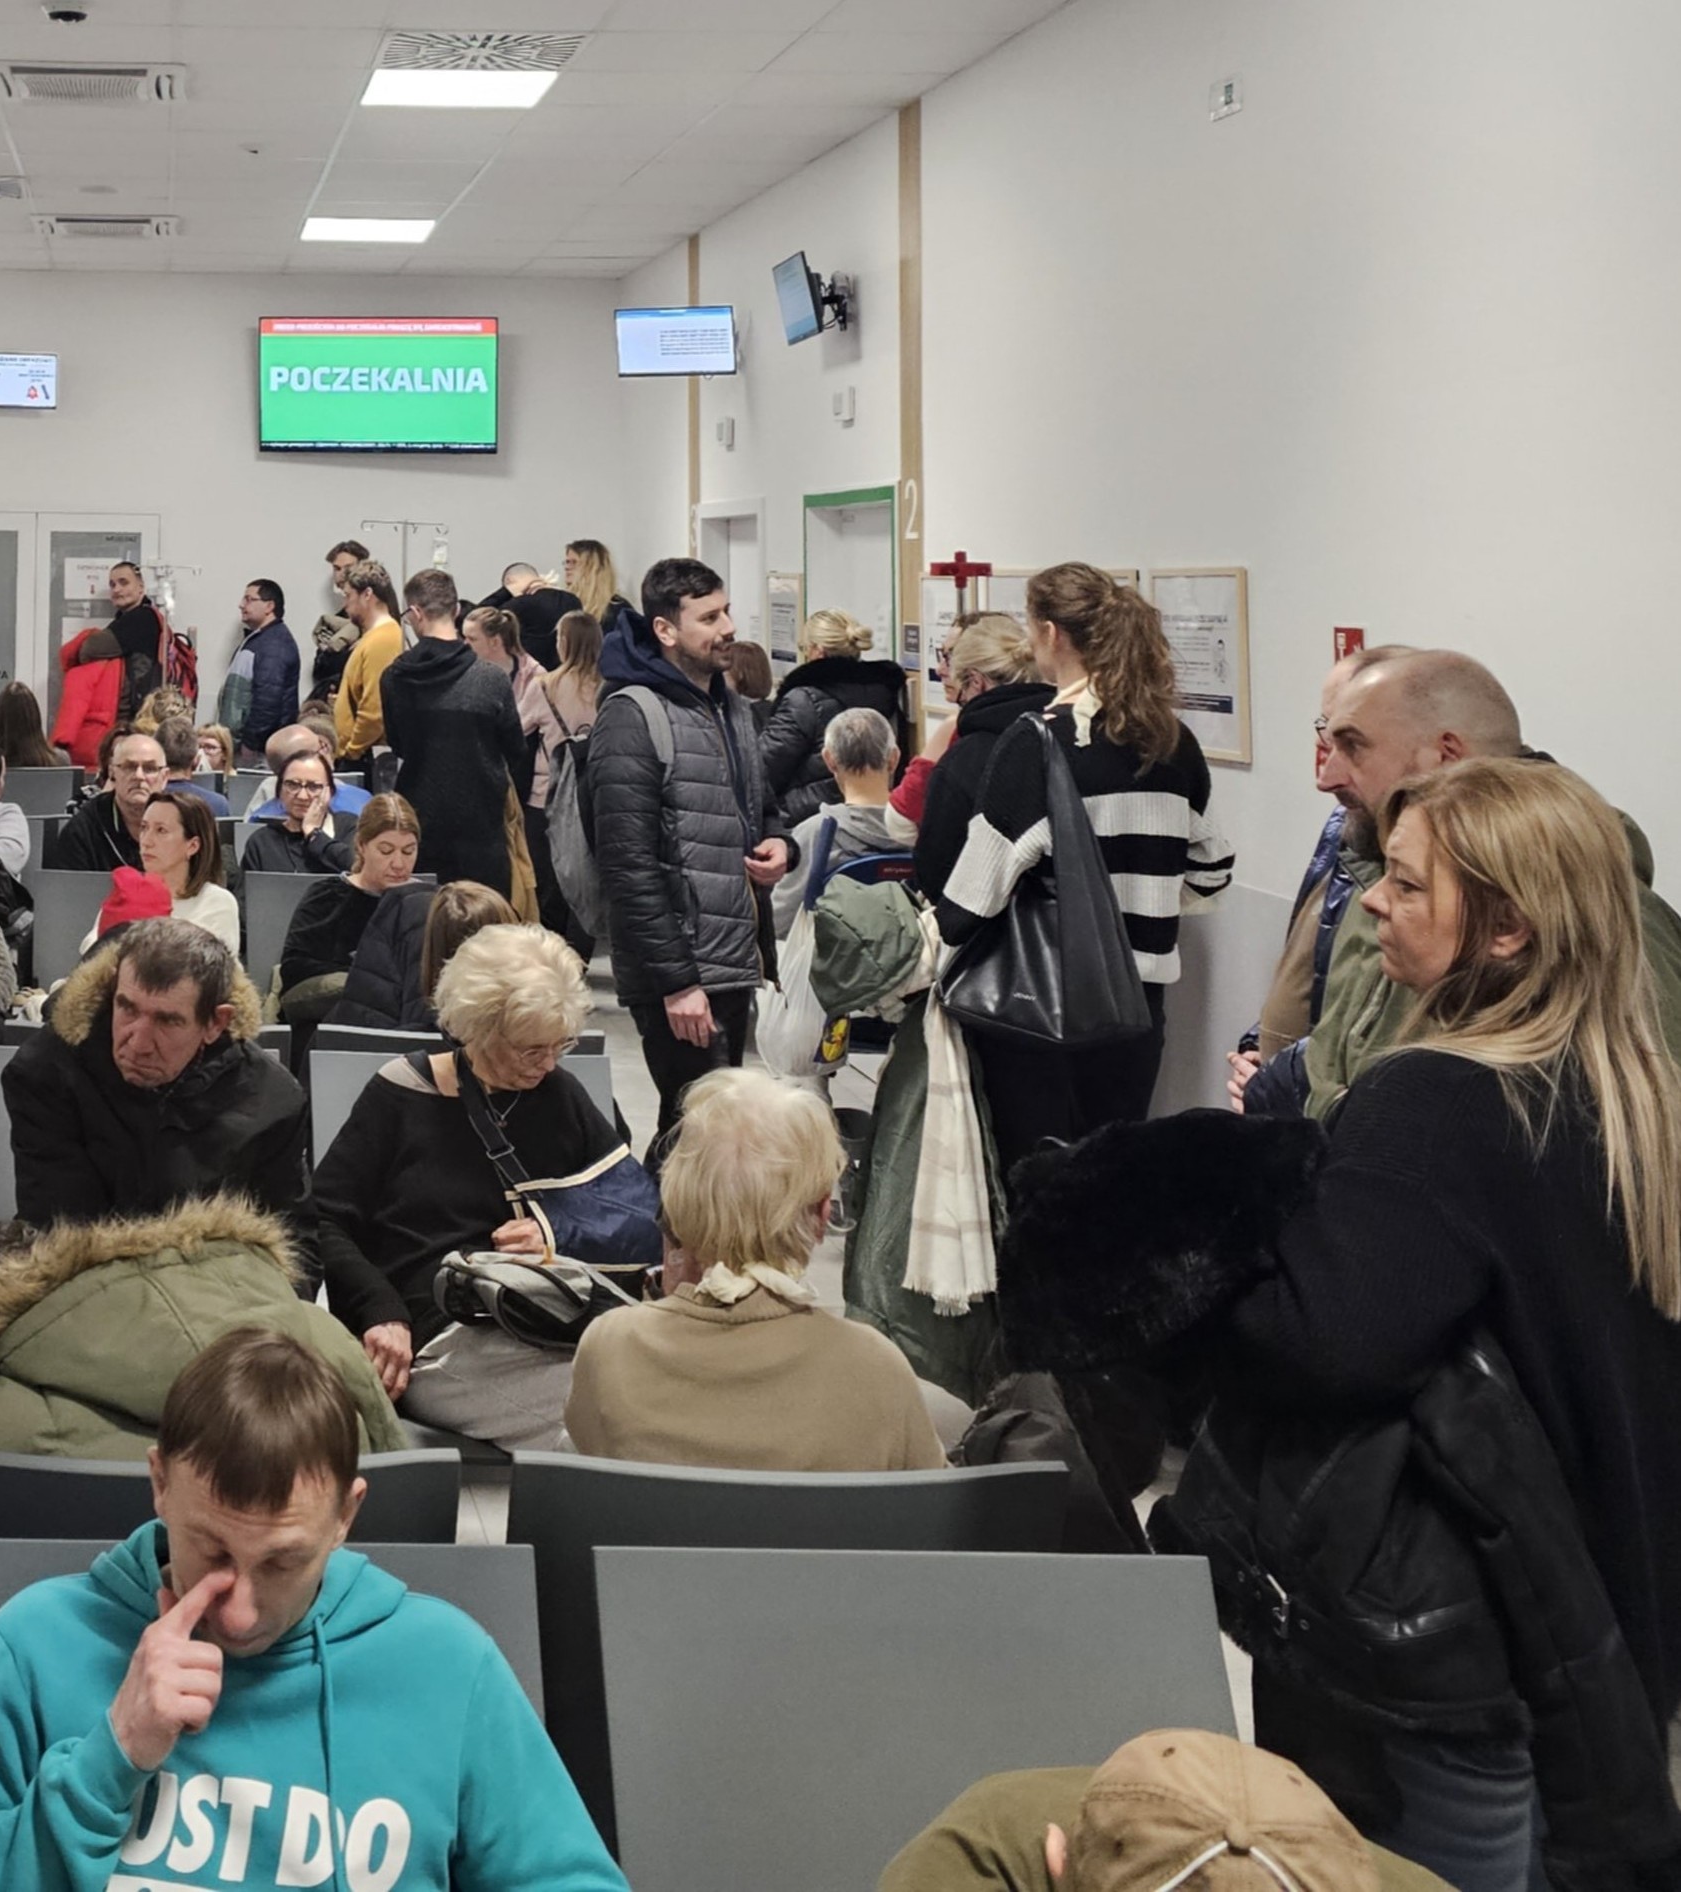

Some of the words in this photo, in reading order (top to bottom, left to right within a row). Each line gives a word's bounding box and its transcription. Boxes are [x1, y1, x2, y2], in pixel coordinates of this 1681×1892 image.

[269, 366, 489, 392] POCZEKALNIA
[904, 478, 919, 540] 2
[118, 1771, 273, 1882] UST
[275, 1786, 411, 1892] DO
